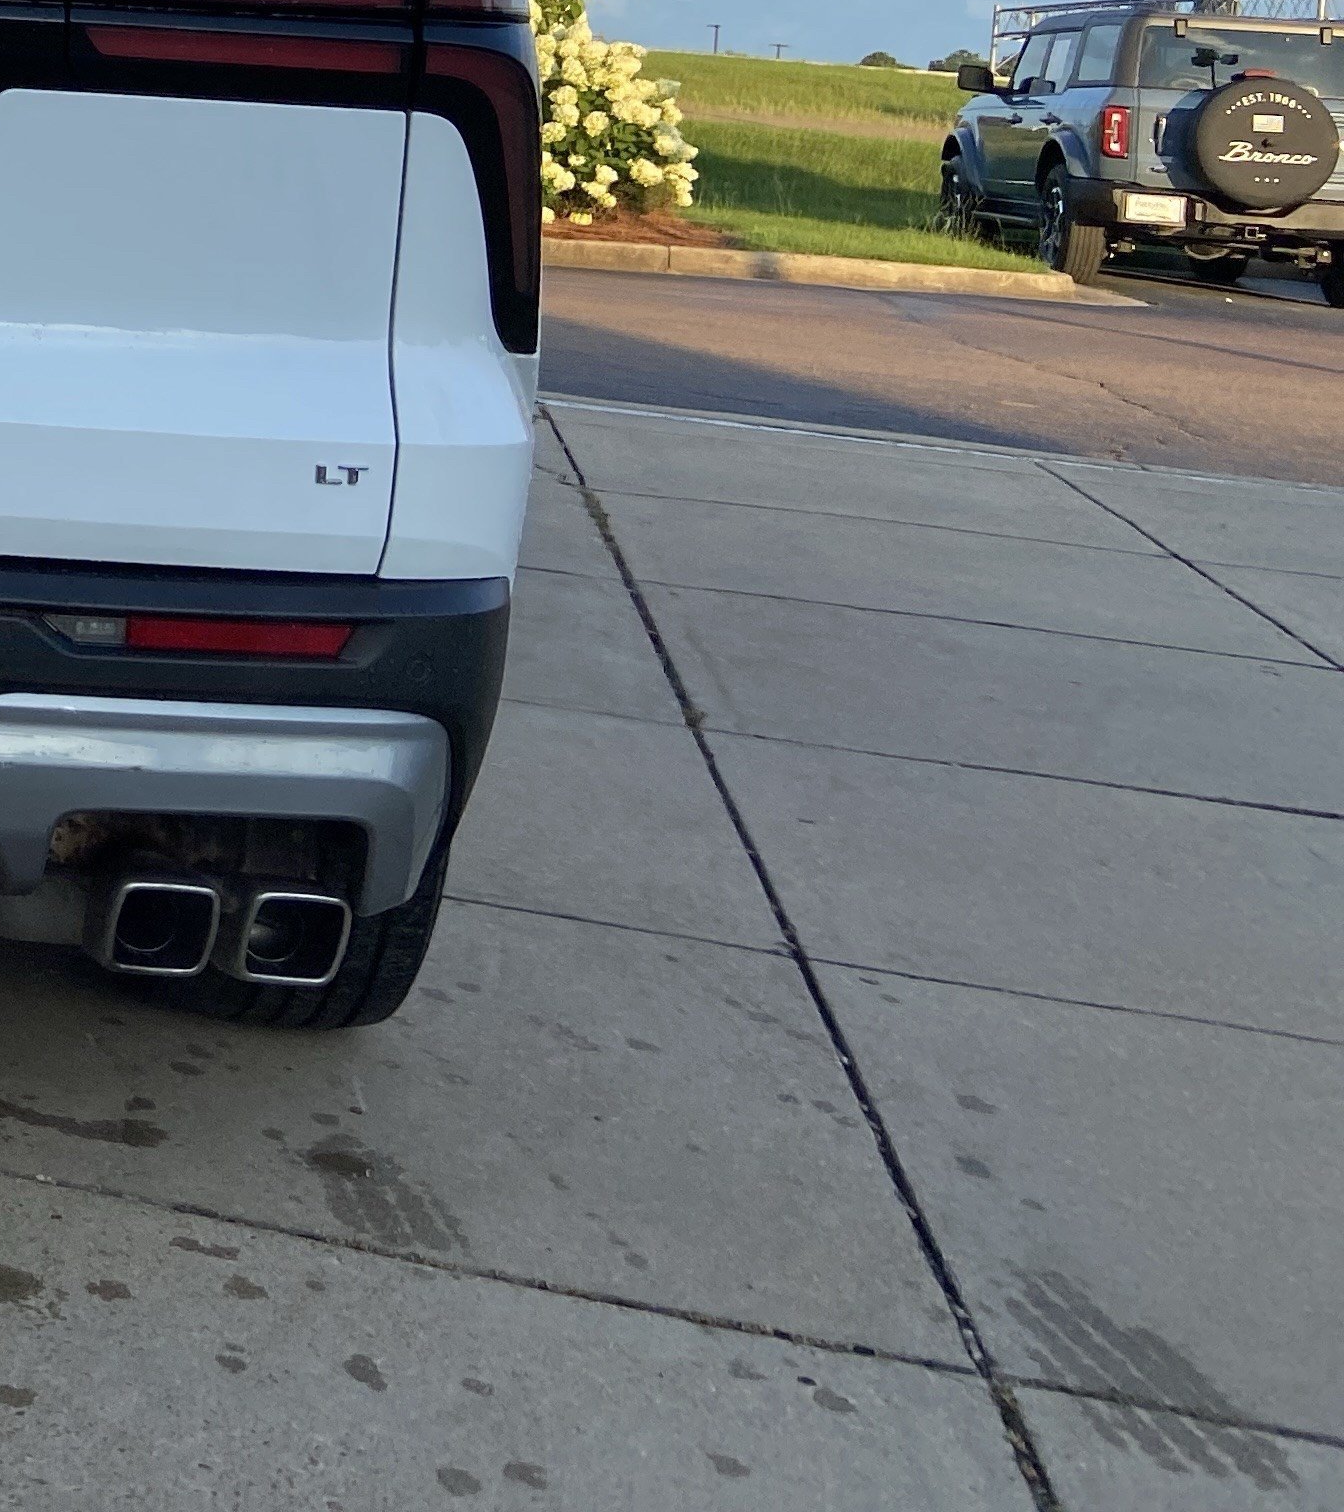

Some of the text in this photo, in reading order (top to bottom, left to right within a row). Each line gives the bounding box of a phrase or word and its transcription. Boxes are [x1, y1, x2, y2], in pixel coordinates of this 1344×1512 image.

[1241, 92, 1266, 106] EST.
[1217, 141, 1318, 165] Bronco
[315, 464, 369, 485] LT
